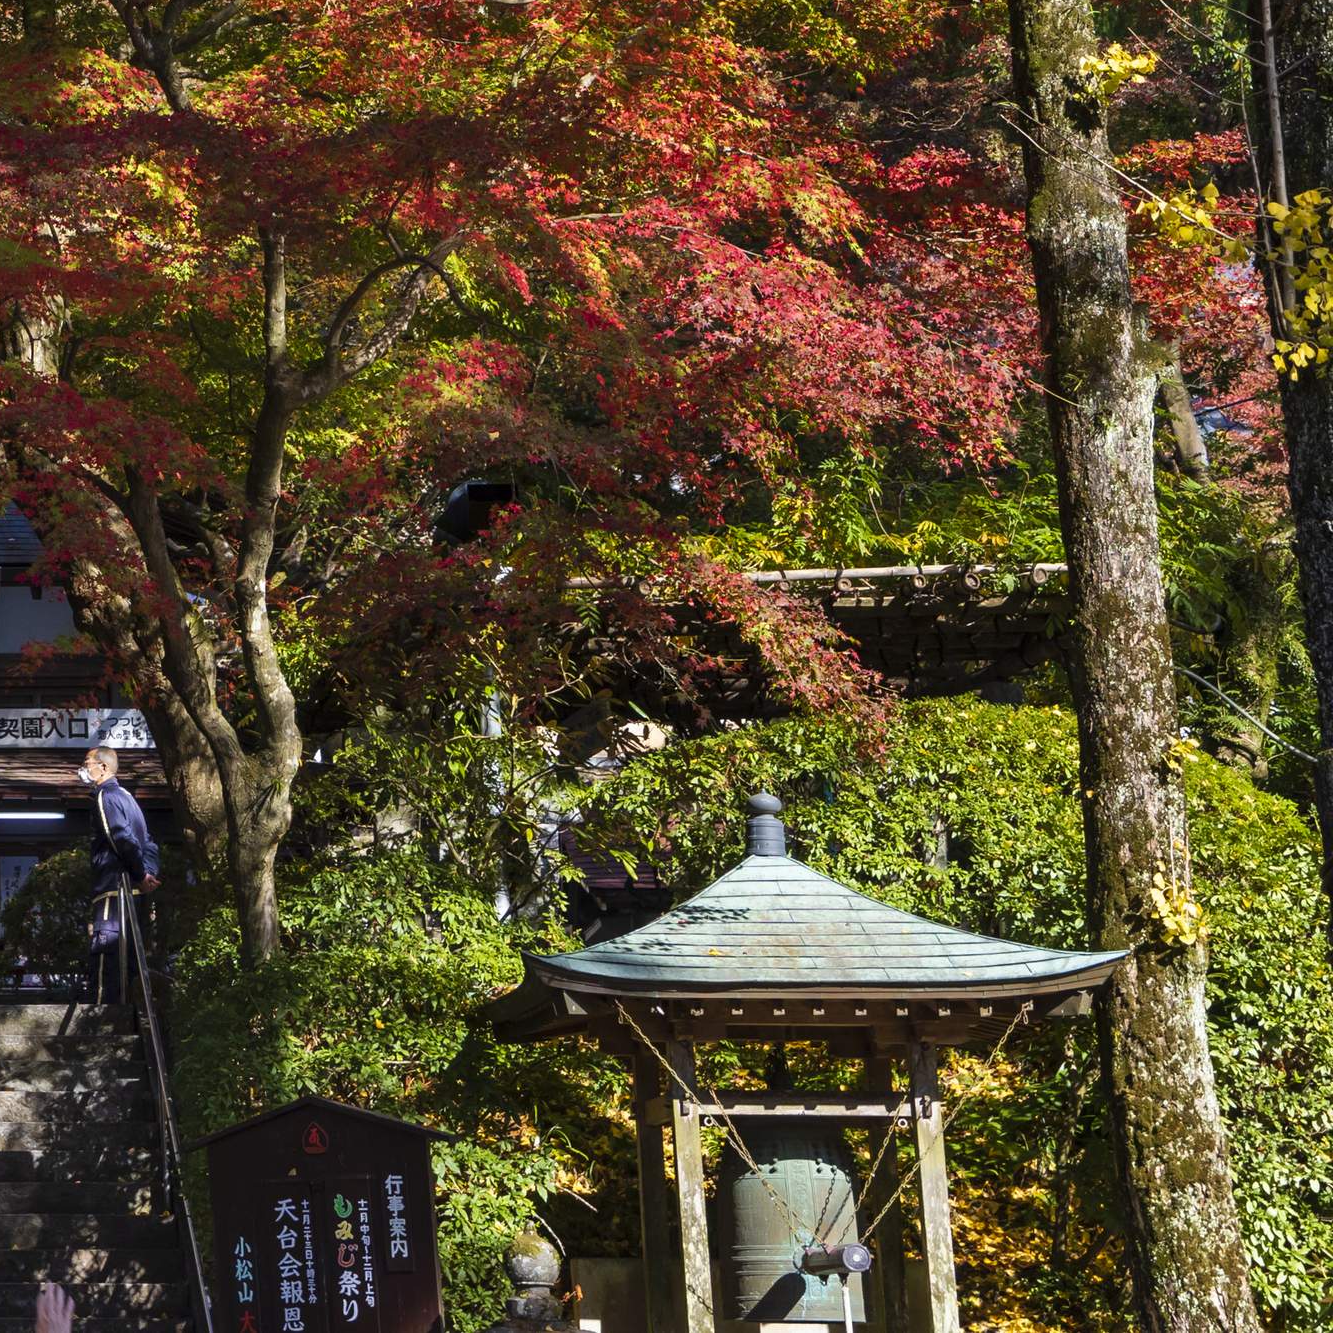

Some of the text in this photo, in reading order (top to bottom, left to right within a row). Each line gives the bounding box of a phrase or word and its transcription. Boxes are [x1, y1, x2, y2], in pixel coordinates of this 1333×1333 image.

[97, 728, 142, 741] 恋人の聖地
[106, 716, 142, 728] つつじ
[301, 1199, 318, 1304] 十一月二十三日十時三十分
[333, 1193, 362, 1323] もみじ祭り
[384, 1174, 409, 1259] 行事案内
[234, 1236, 257, 1333] 小松山 大
[274, 1198, 306, 1333] 天台会報恩
